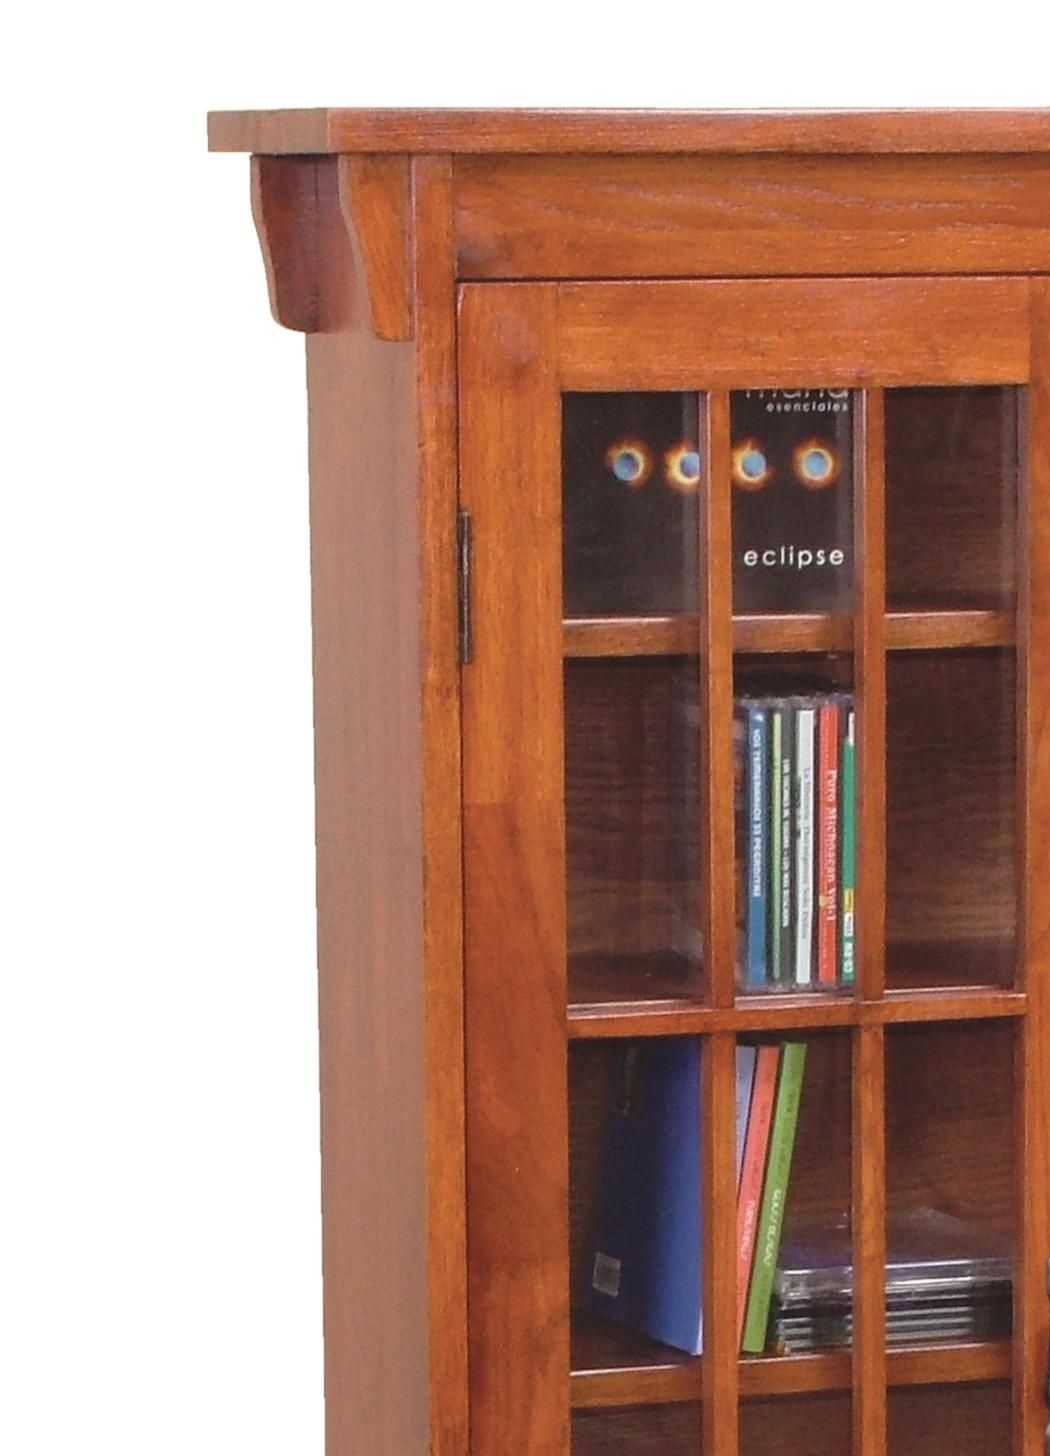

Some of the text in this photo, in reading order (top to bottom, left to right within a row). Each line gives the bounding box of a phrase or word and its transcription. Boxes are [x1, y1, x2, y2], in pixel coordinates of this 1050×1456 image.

[765, 401, 849, 413] esenciales
[743, 545, 844, 570] eclipse
[826, 768, 837, 802] Puro
